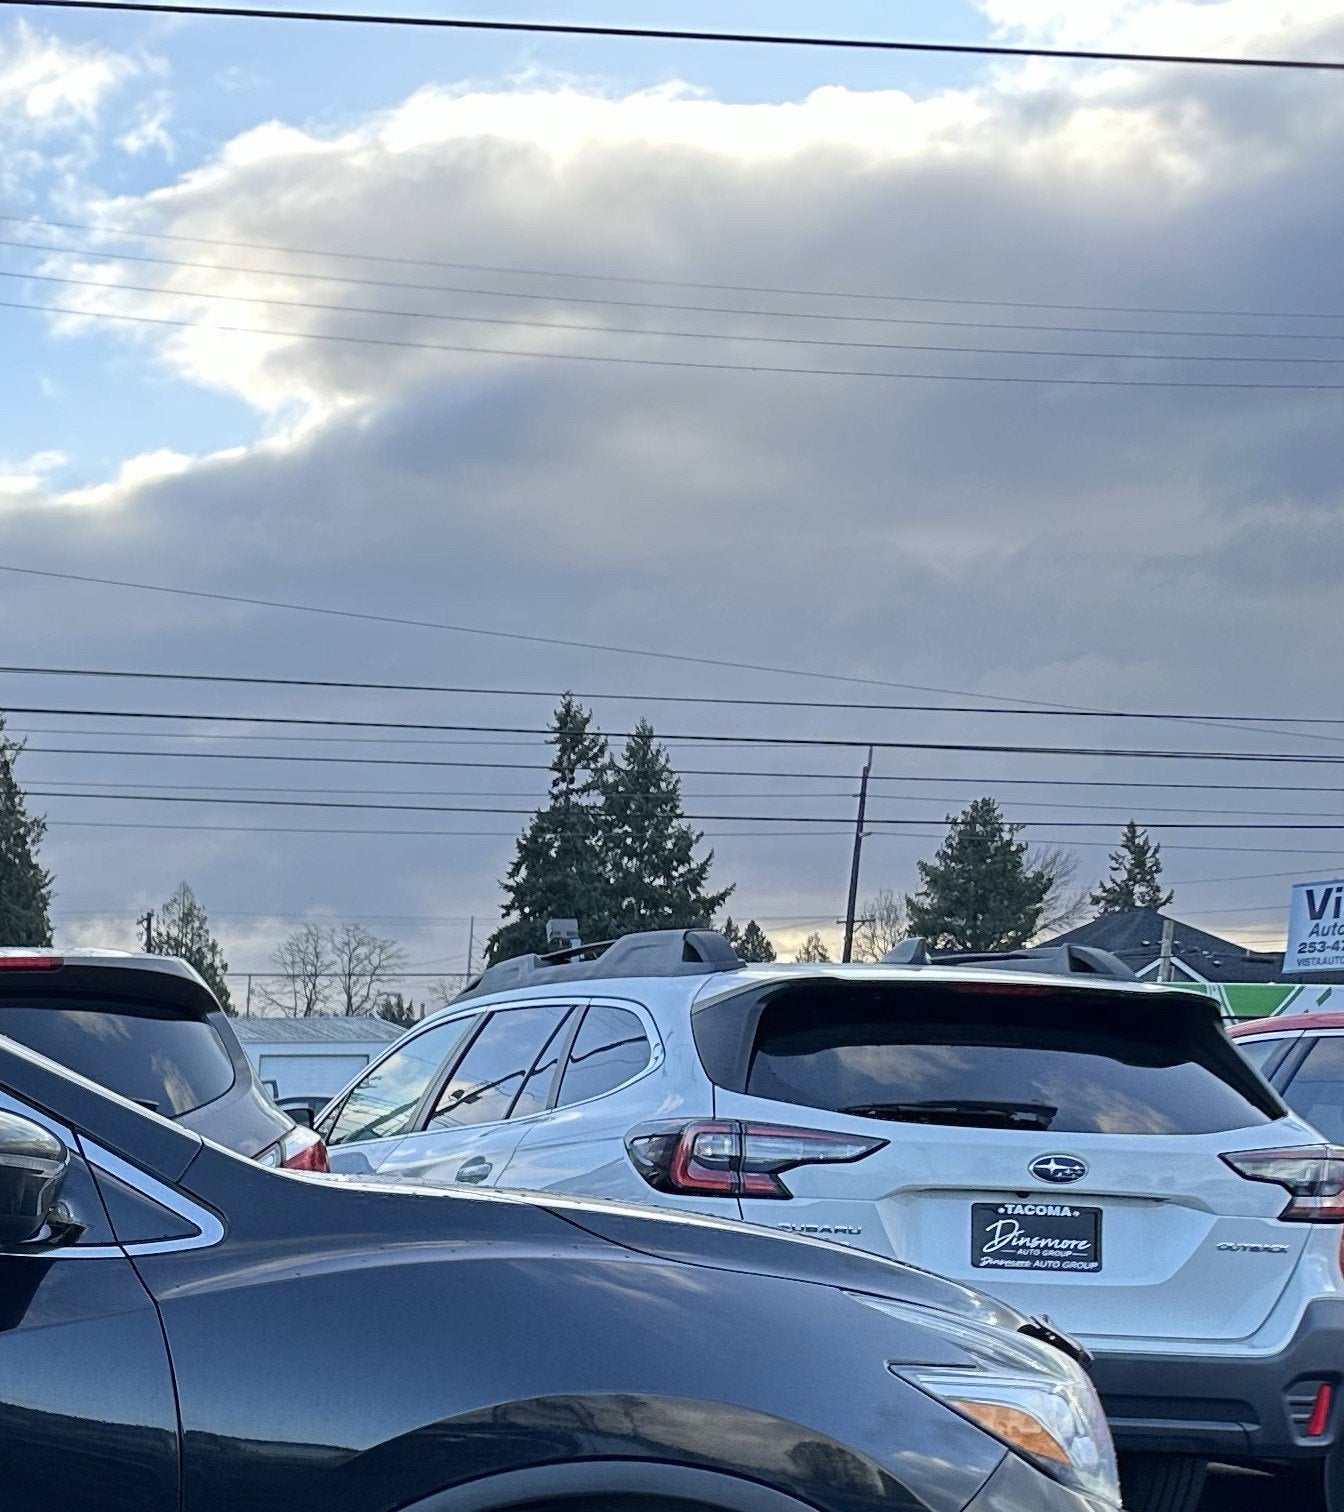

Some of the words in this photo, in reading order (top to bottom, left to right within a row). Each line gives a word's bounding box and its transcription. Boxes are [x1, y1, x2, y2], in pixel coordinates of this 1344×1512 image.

[1004, 1204, 1072, 1217] TACOMA
[982, 1219, 1091, 1253] Dinsmore
[1016, 1248, 1040, 1256] AUTO
[1041, 1249, 1072, 1257] GROUP
[1032, 1260, 1060, 1269] AUTO
[1062, 1261, 1099, 1270] GROUP
